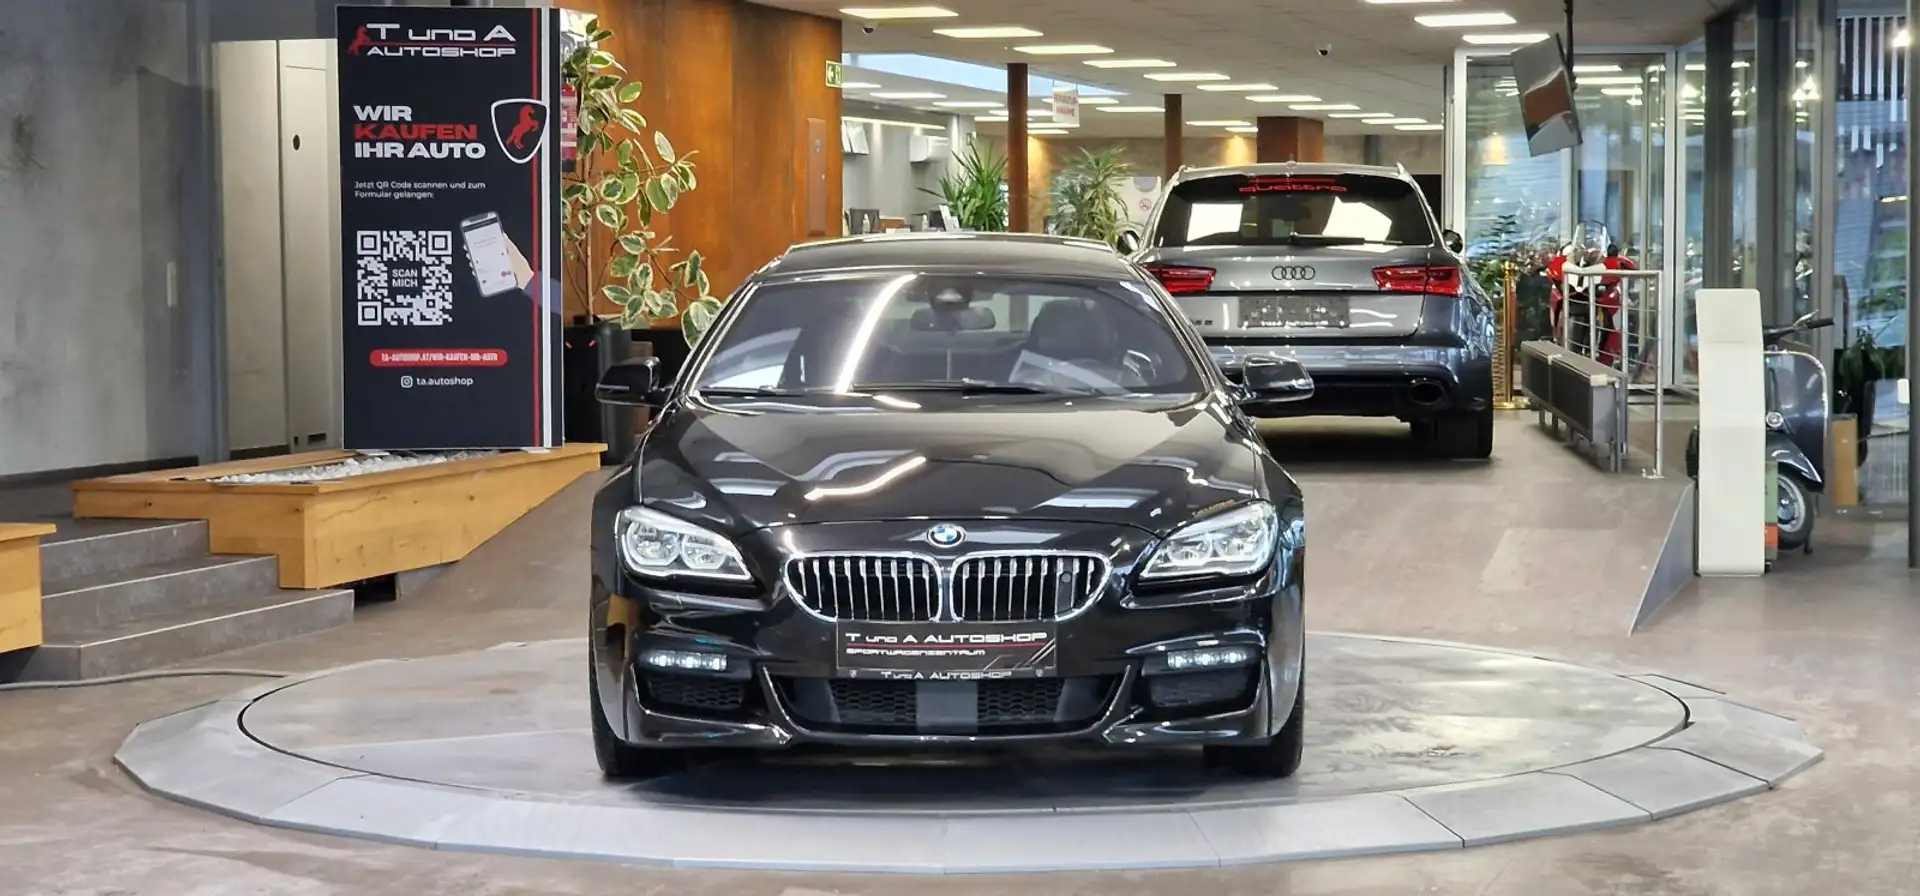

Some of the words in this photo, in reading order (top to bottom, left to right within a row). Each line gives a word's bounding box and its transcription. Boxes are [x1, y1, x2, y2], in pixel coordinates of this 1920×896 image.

[366, 23, 400, 40] T
[484, 25, 516, 42] A
[366, 46, 516, 58] AUTOSHOP
[353, 105, 412, 122] WIR
[354, 124, 477, 140] KAUFEN
[354, 142, 405, 158] IHR
[407, 142, 486, 159] AUTO
[354, 181, 374, 189] Jetzt
[376, 181, 389, 189] QR
[390, 181, 412, 189] Code
[450, 181, 466, 189] und
[392, 269, 418, 278] SCAN
[392, 279, 418, 287] MICH
[416, 377, 474, 386] ta.autoshop
[845, 633, 861, 643] T
[903, 635, 918, 643] A
[924, 632, 1047, 643] AUTOSHOP
[881, 671, 892, 679] T
[912, 671, 924, 679] A
[929, 671, 1012, 679] AUTOSHOP
